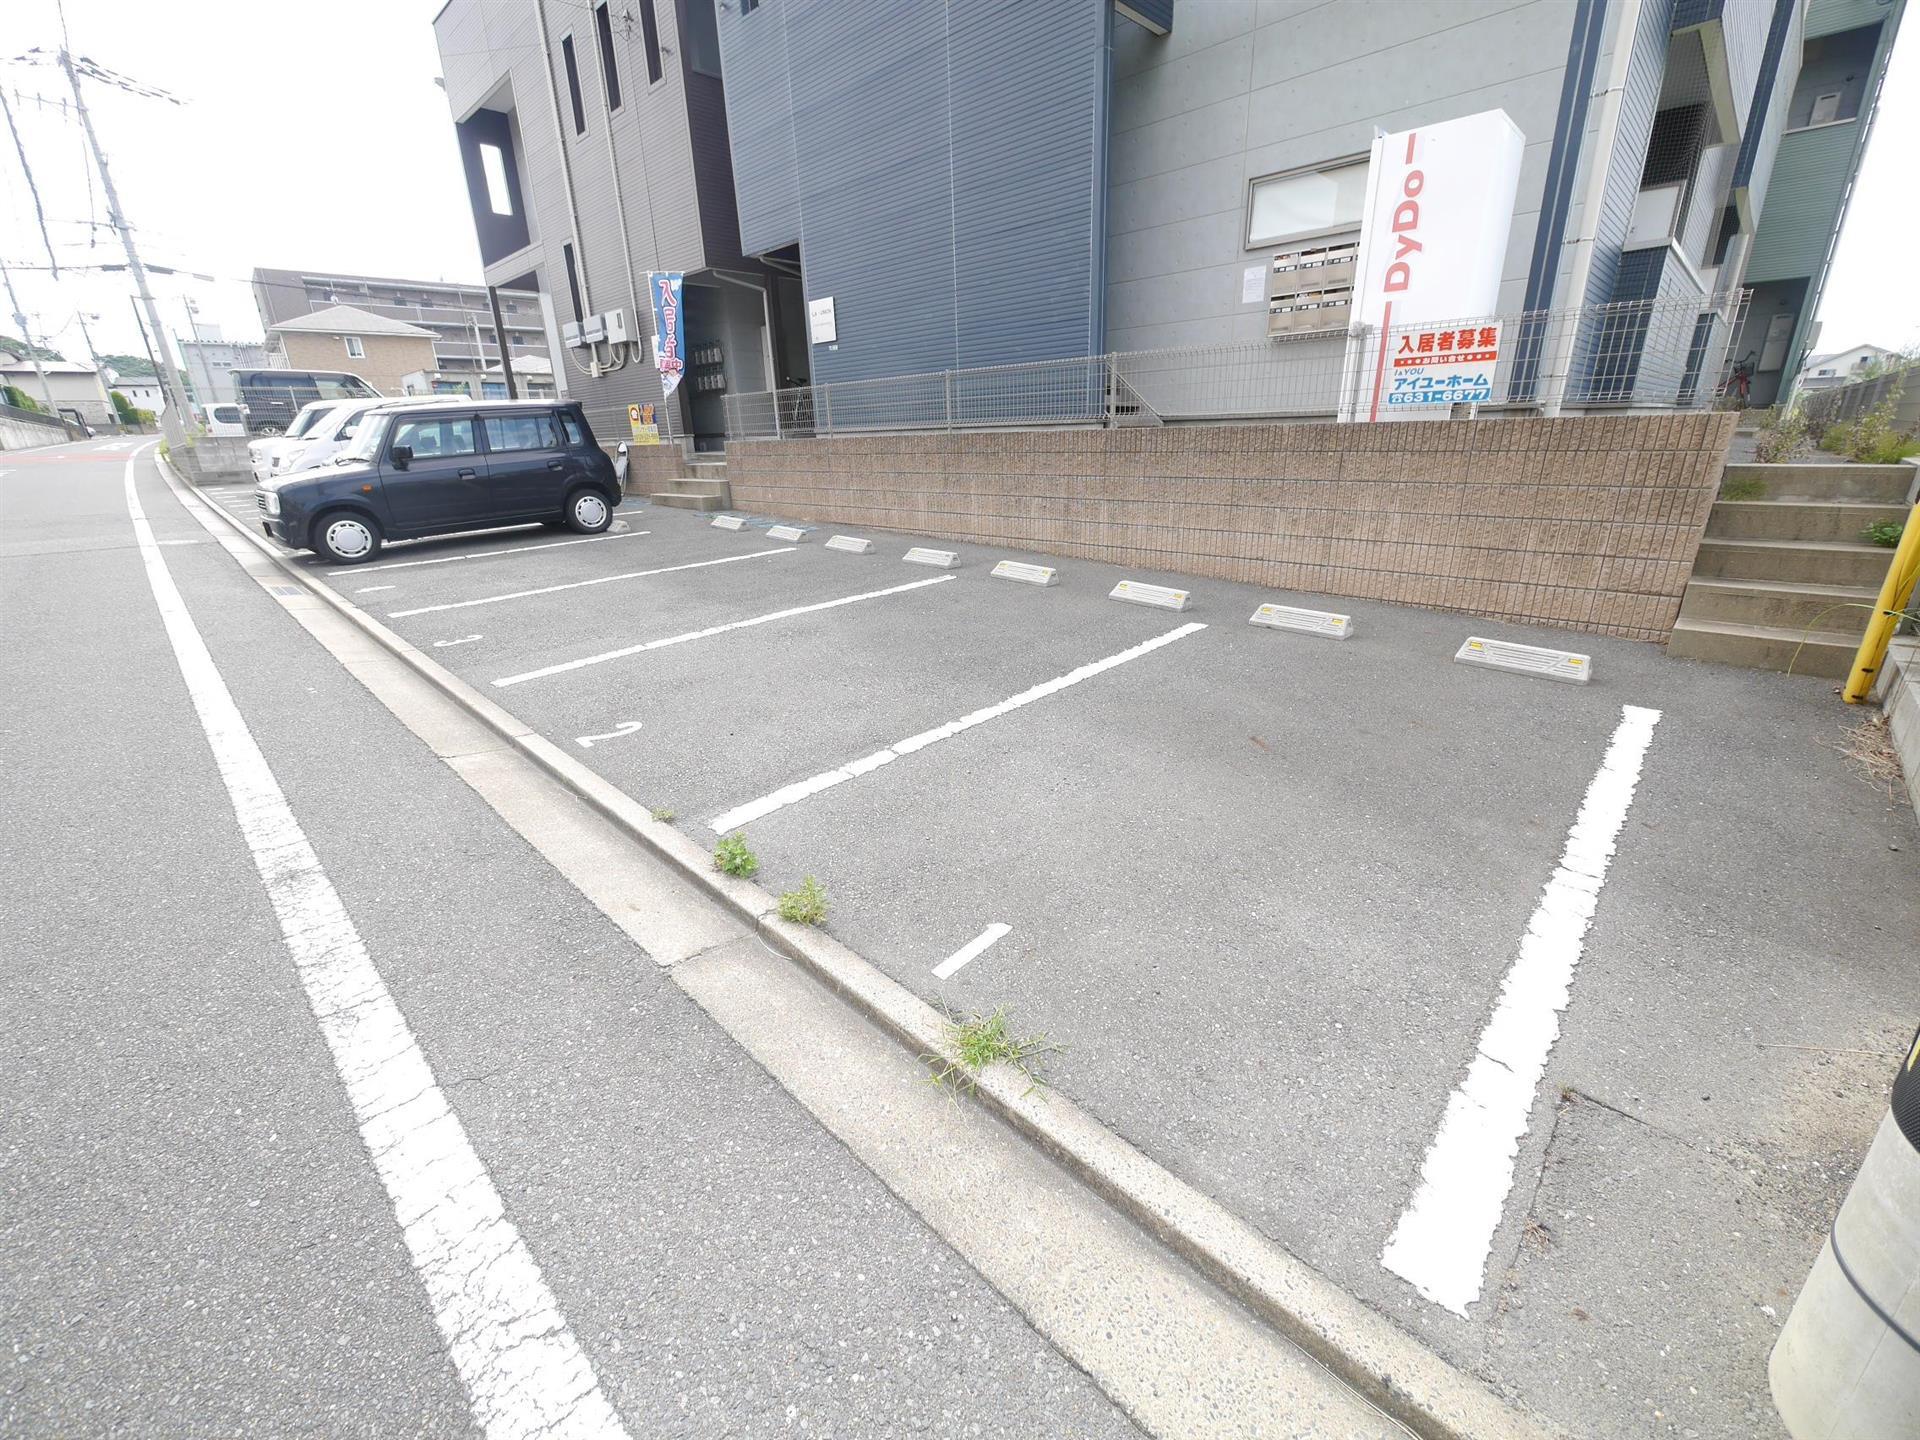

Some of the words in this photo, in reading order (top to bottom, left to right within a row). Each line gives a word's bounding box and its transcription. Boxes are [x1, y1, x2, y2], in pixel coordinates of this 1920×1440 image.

[1384, 170, 1424, 292] DyDo
[1398, 327, 1497, 354] 入居者募集
[1394, 373, 1488, 390] アイユーホーム
[575, 721, 643, 748] 2
[931, 922, 1013, 980] 1
